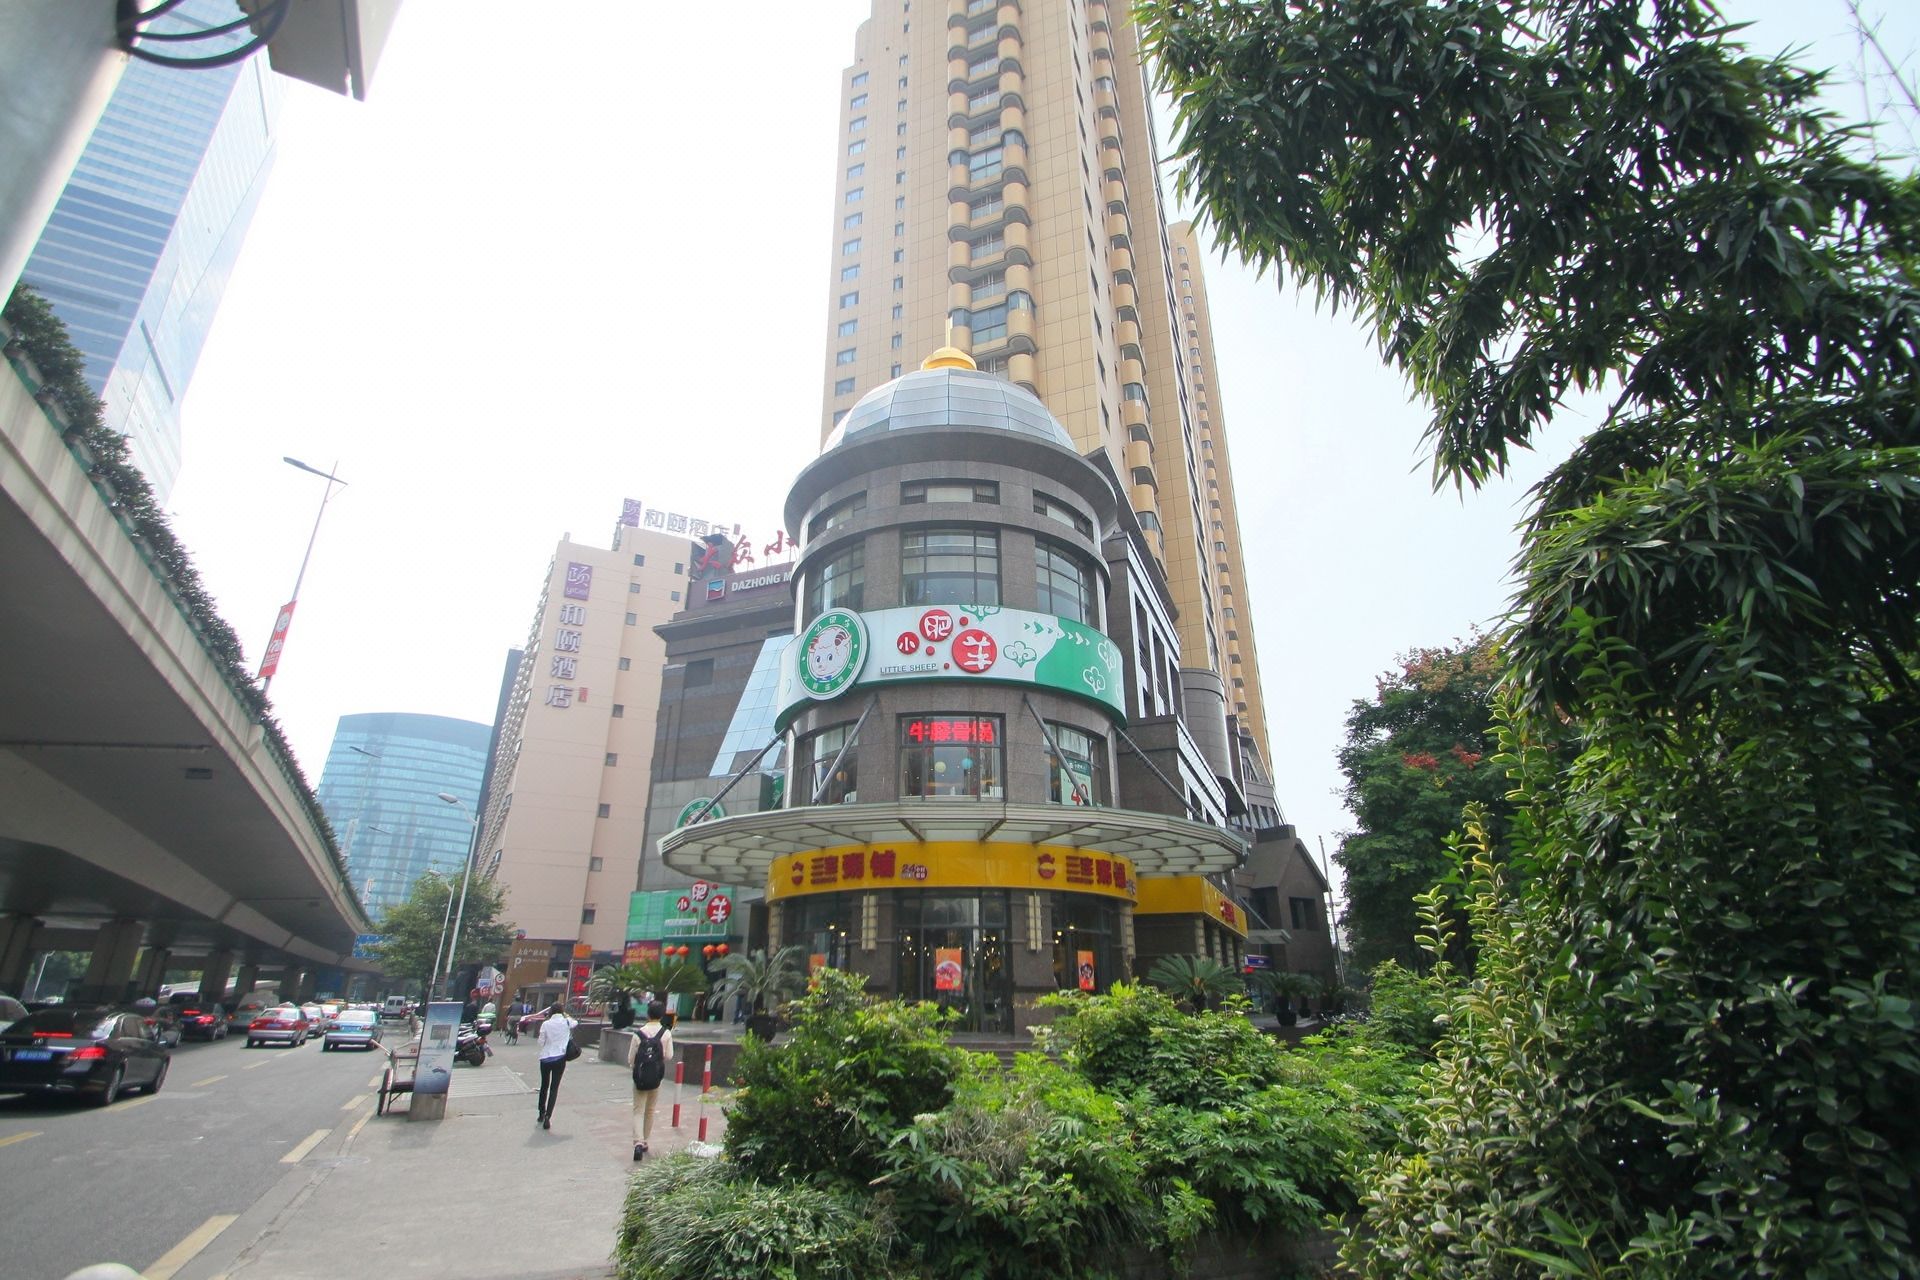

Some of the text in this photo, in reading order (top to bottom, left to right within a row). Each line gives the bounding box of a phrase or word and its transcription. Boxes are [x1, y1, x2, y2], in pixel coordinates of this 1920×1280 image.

[731, 574, 780, 592] DAZHONG
[544, 603, 586, 709] 和颐酒店
[898, 614, 994, 671] 小肥羊
[880, 663, 937, 674] LITTLE SHEEP
[677, 882, 733, 923] 小肥羊
